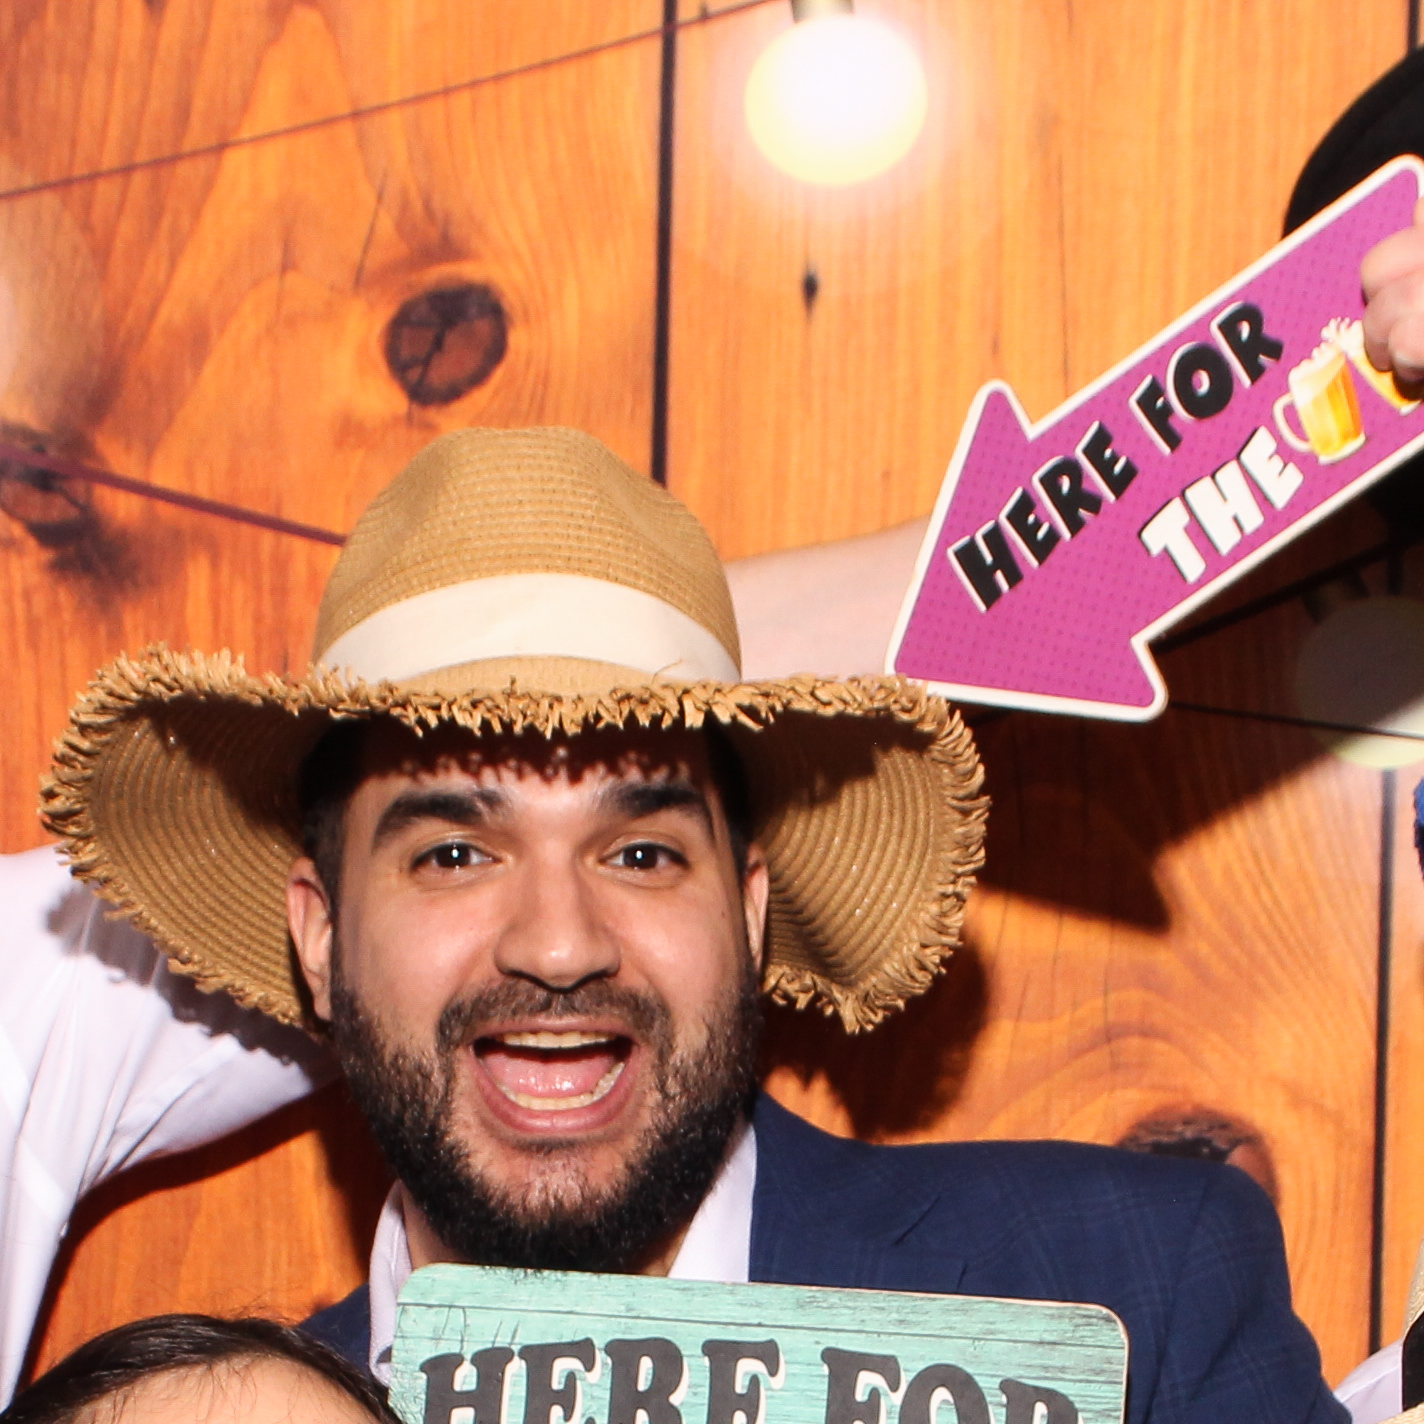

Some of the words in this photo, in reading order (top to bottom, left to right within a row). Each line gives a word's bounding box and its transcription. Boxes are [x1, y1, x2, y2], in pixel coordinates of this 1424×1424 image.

[947, 419, 1138, 614] HERE
[1128, 300, 1284, 456] FOR
[1137, 425, 1304, 585] THE
